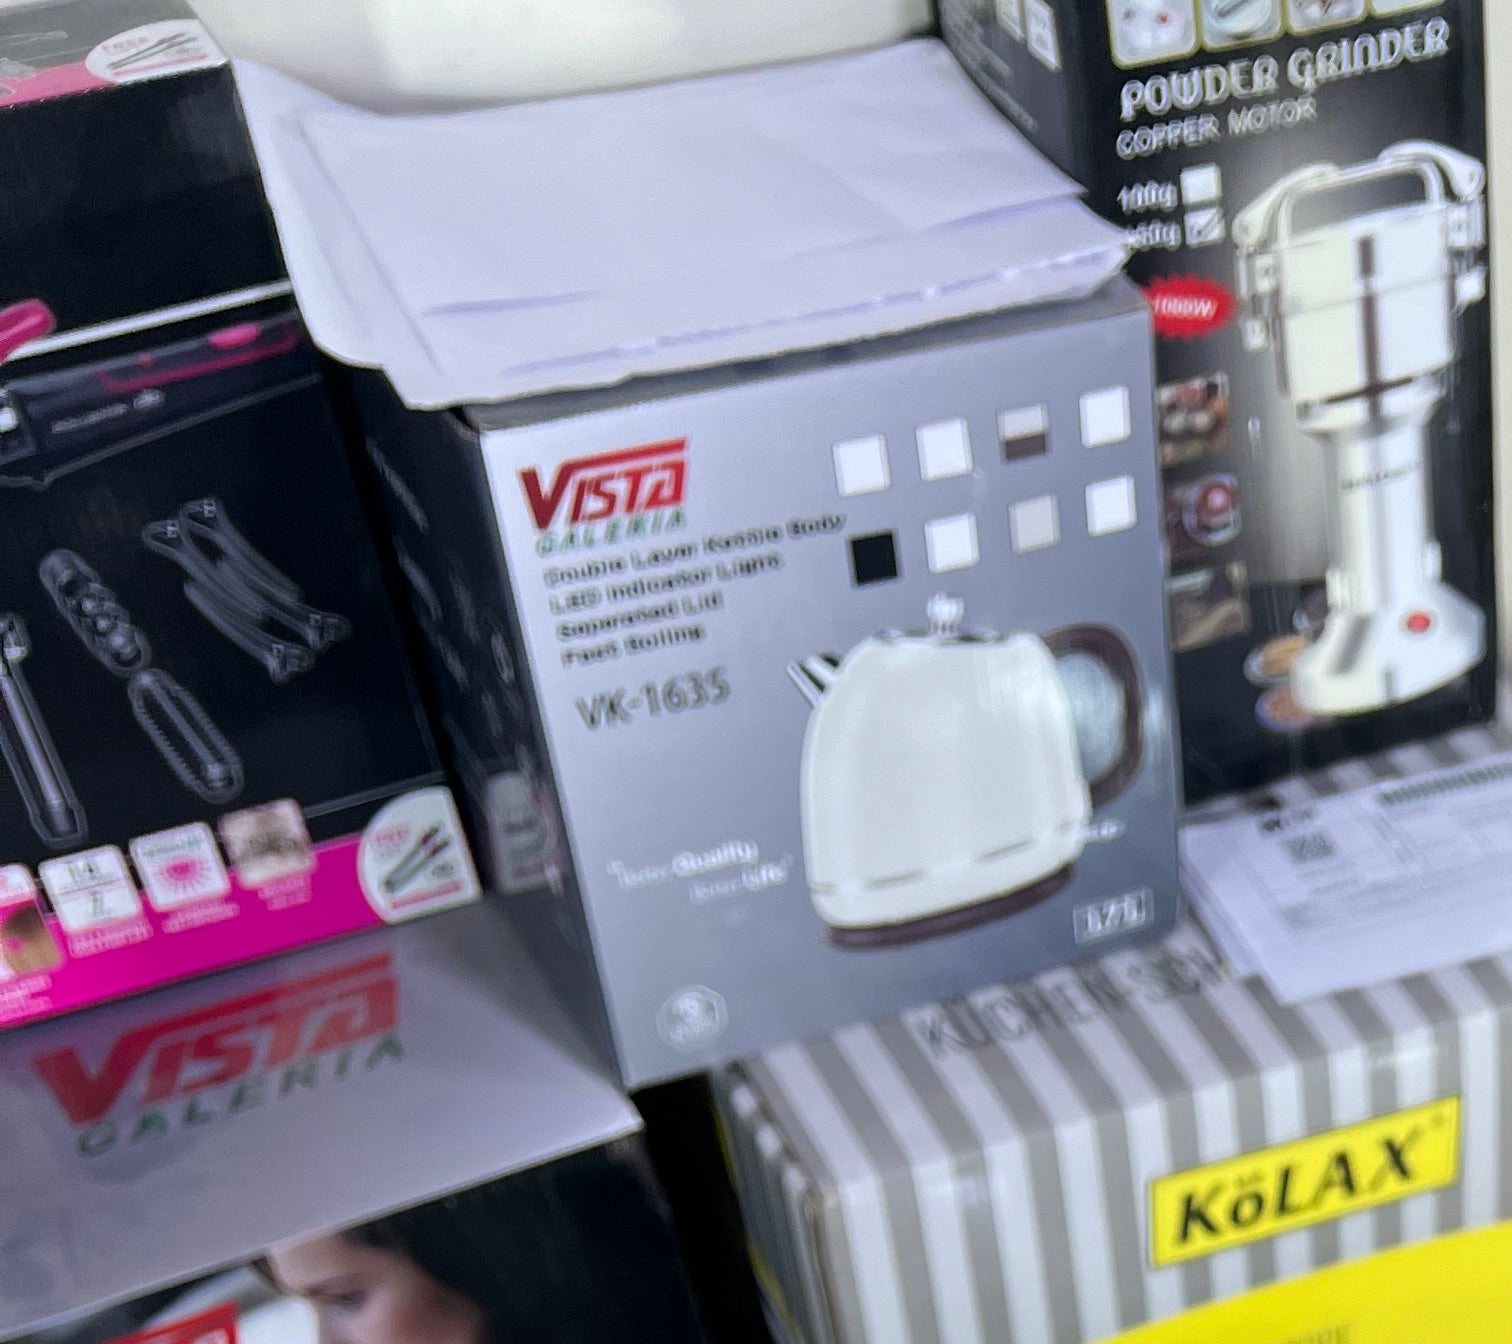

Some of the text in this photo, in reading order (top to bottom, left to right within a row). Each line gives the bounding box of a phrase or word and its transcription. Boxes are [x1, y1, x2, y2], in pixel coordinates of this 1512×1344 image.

[1119, 55, 1279, 121] POWDER
[1288, 18, 1450, 92] GRINDER
[1115, 97, 1317, 160] COPPER MOTOR
[1117, 180, 1178, 214] 100g
[518, 434, 688, 531] VISTA
[536, 508, 688, 557] GALERIA
[545, 556, 630, 588] Double
[631, 543, 702, 573] Layer
[786, 513, 846, 542] Body
[551, 590, 602, 614] LED
[605, 565, 713, 600] Indicator
[682, 589, 724, 614] Lid
[623, 624, 706, 655] Boiling
[576, 666, 731, 731] VK-1635
[672, 840, 759, 877] Quality
[33, 953, 397, 1127] VISTA
[78, 1040, 403, 1157] GALERIA
